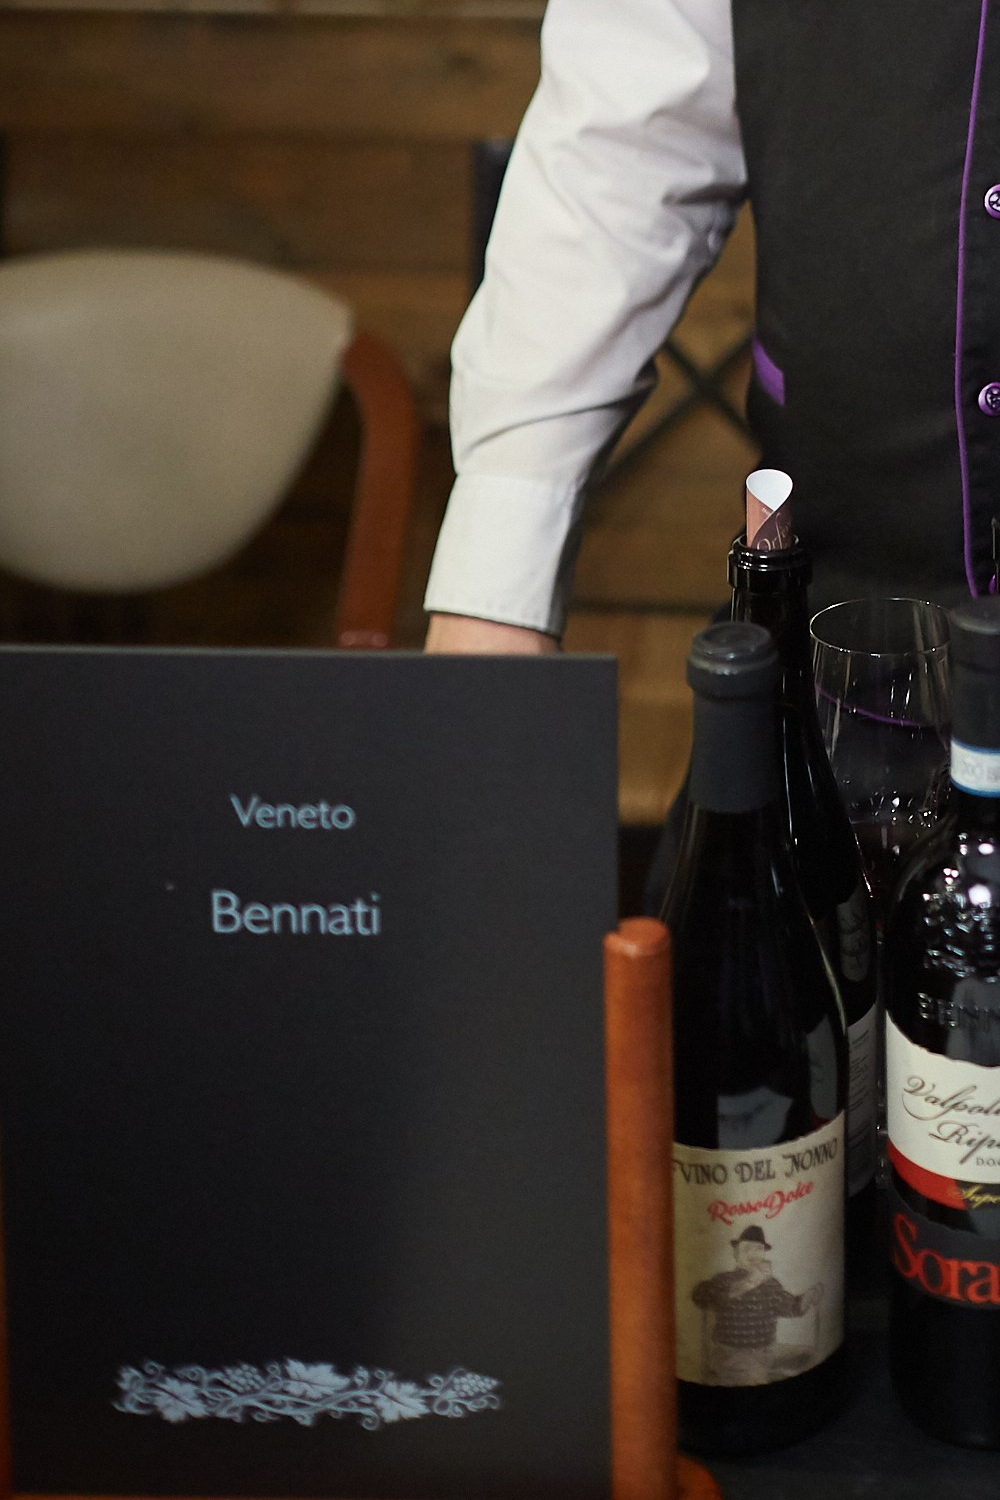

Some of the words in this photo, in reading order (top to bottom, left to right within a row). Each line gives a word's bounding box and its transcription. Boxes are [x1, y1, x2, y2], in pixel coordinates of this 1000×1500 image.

[230, 793, 355, 830] Veneto
[211, 889, 380, 936] Bennati
[672, 1159, 728, 1185] VINO
[734, 1158, 777, 1184] DEL
[782, 1136, 839, 1179] NONNO
